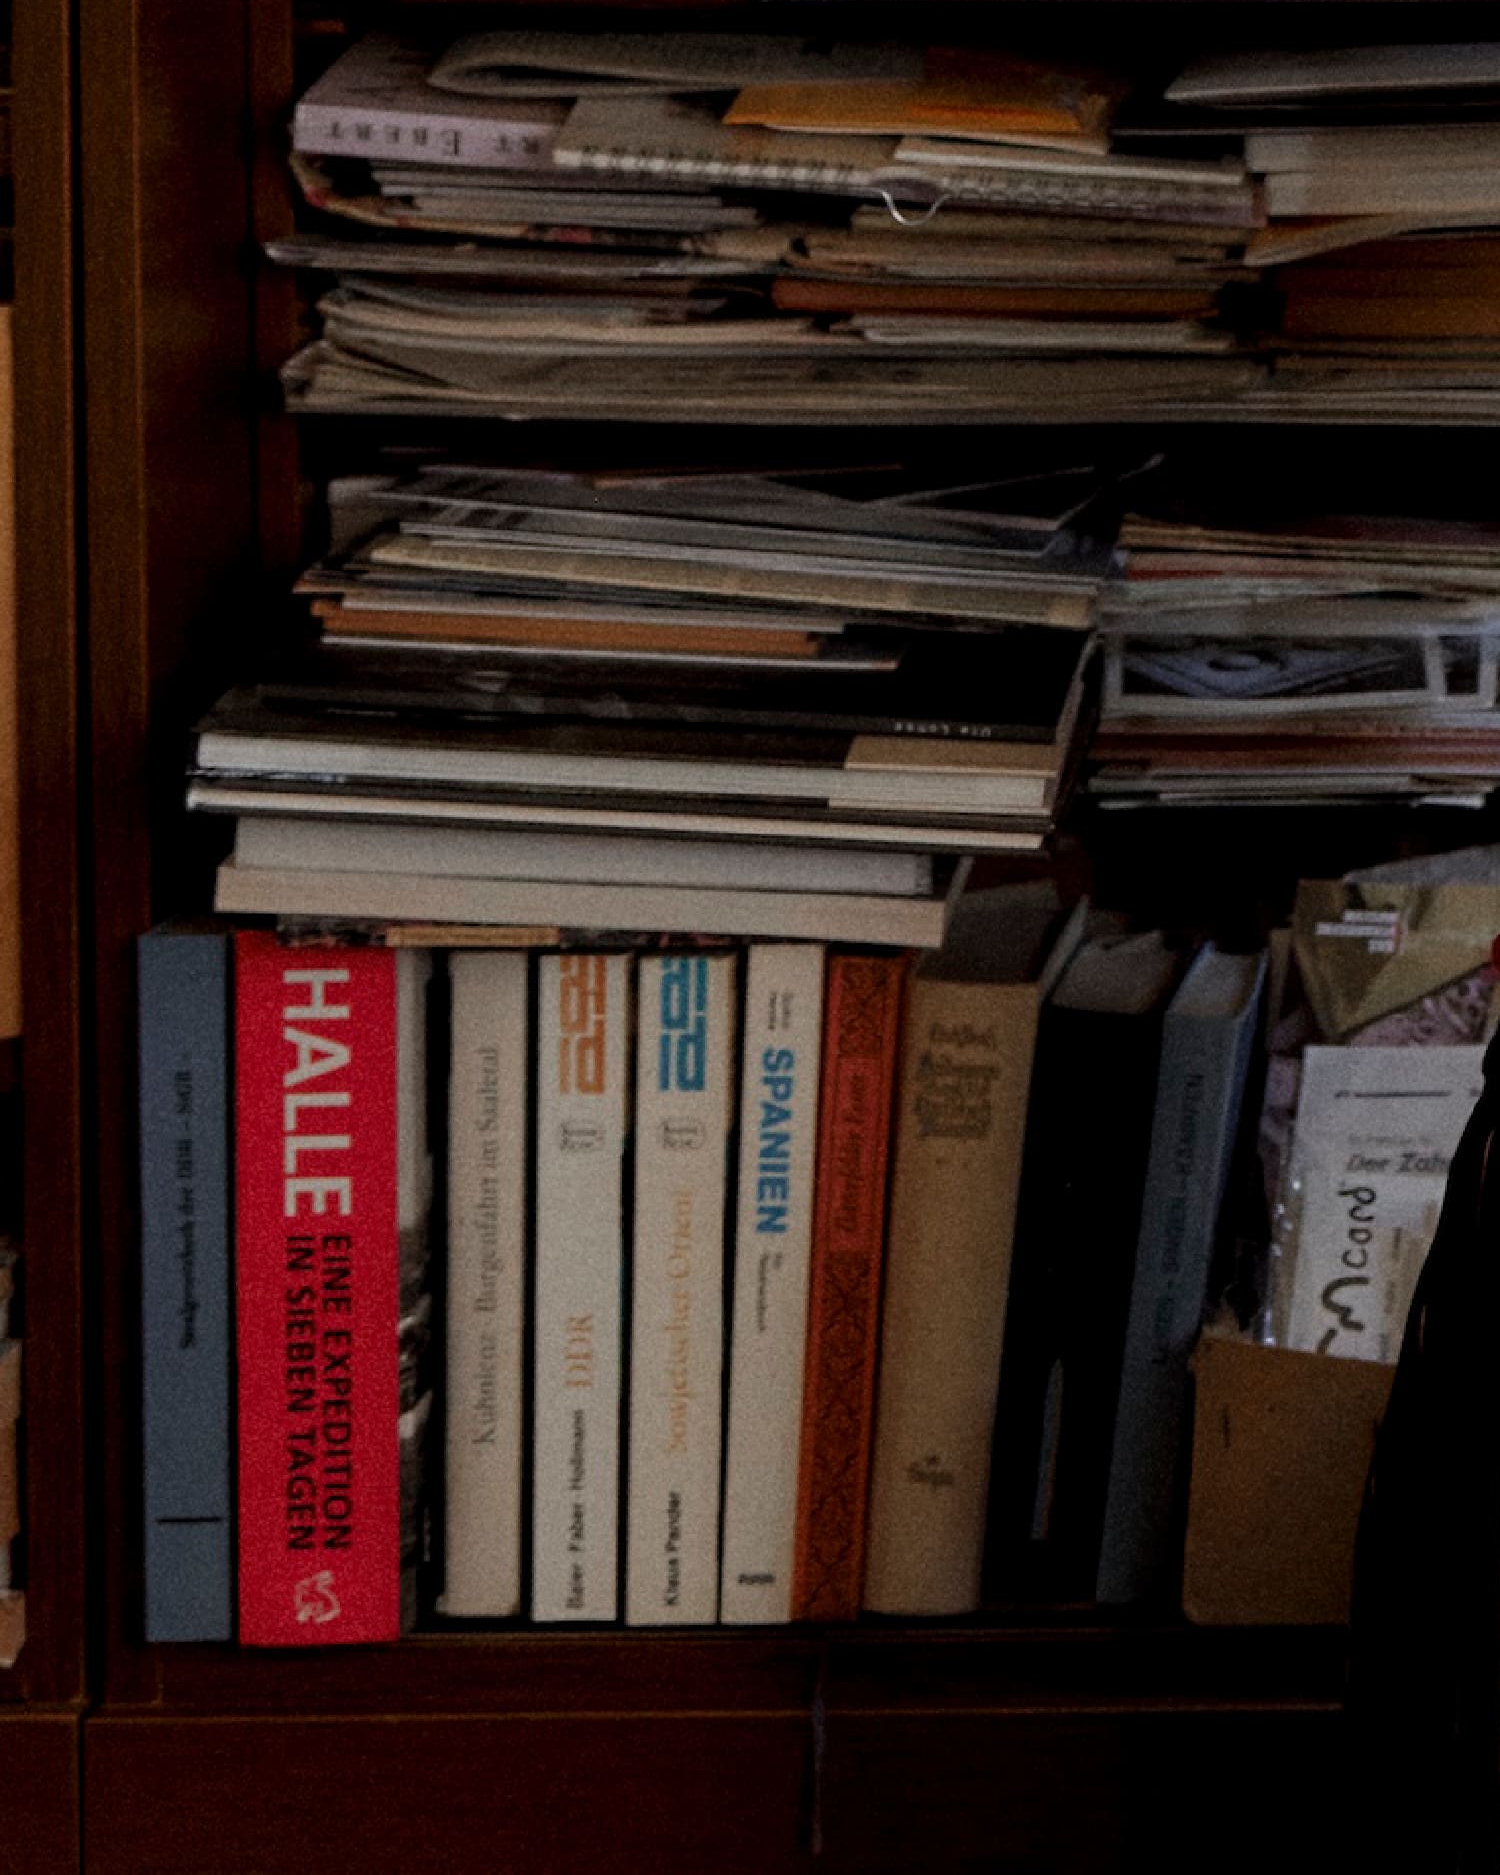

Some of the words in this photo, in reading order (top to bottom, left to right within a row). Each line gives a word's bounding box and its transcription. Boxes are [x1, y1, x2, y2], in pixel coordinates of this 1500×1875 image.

[282, 968, 352, 1218] HALLE
[755, 1047, 796, 1234] SPANIEN
[285, 1234, 316, 1271] IN
[320, 1234, 352, 1313] EINE
[284, 1286, 316, 1411] SIEBEN
[284, 1430, 316, 1551] TAGEN
[321, 1329, 352, 1551] EXPEDITION
